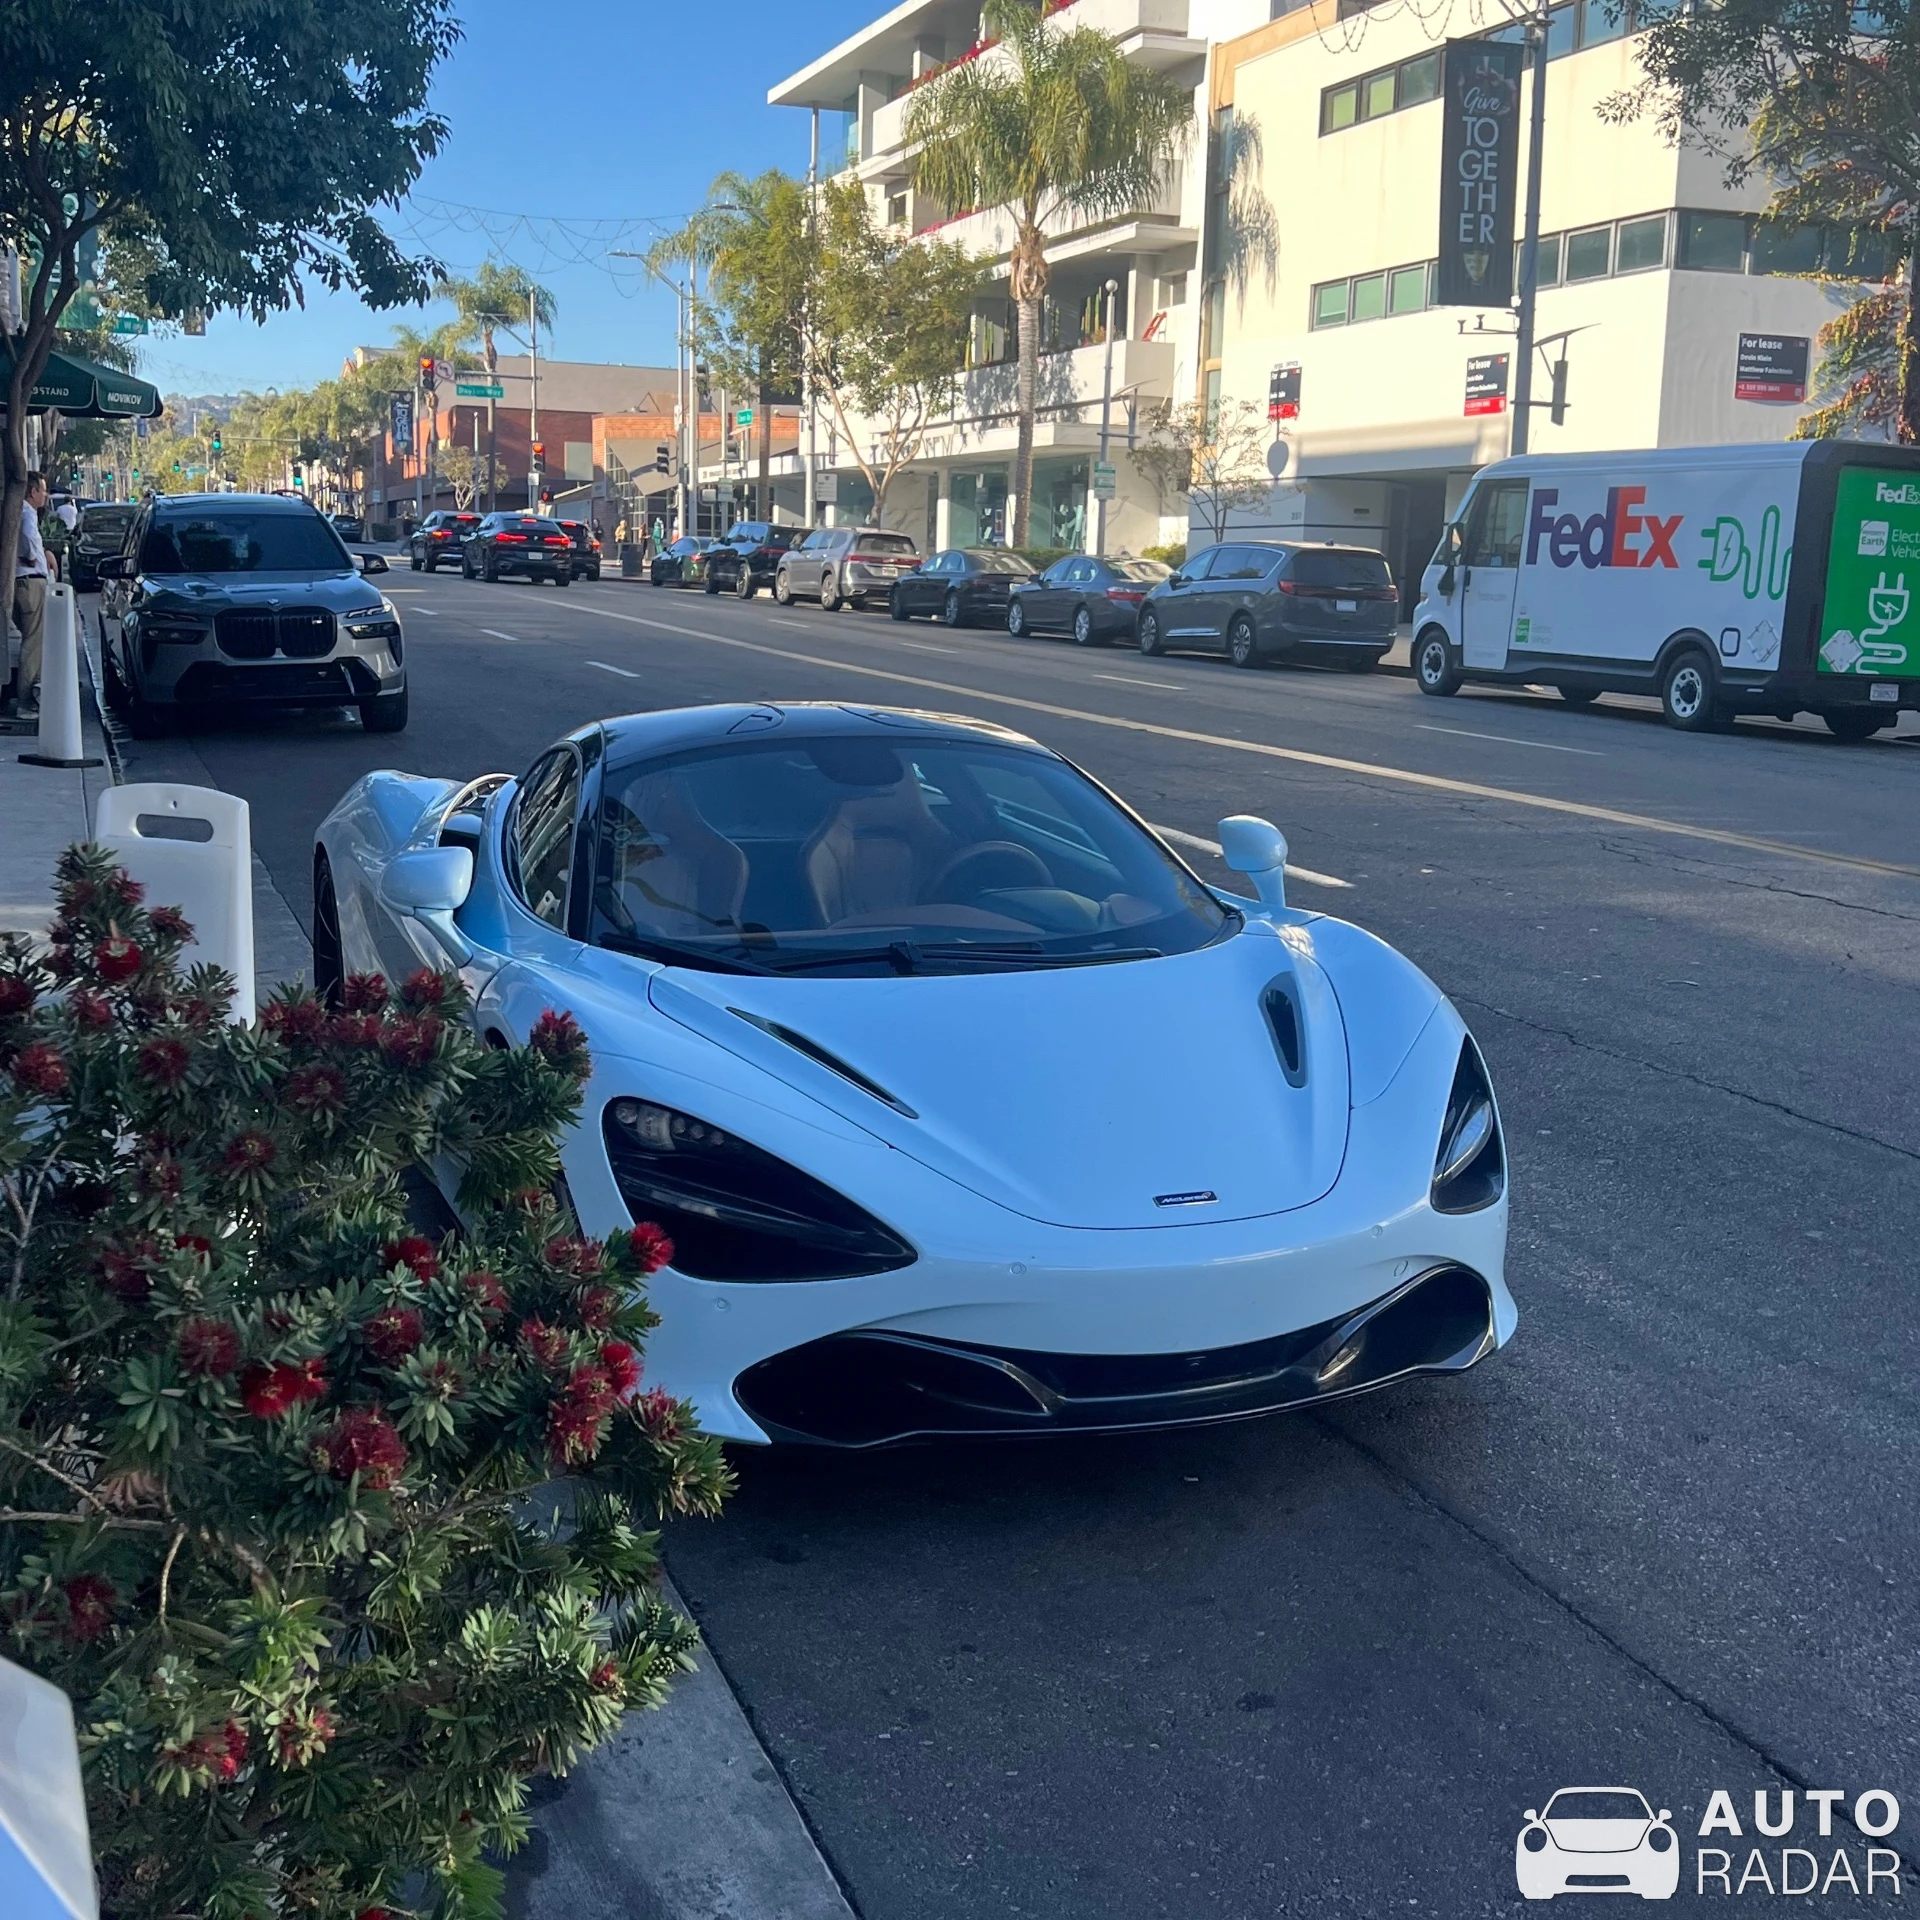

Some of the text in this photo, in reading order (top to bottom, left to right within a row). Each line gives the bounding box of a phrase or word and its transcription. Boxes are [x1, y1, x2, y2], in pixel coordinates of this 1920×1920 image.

[1463, 86, 1501, 114] Give
[1741, 338, 1783, 349] For lease
[107, 392, 143, 405] NOVIKOV
[1526, 486, 1684, 568] FedEx
[1861, 536, 1885, 546] Earth
[1161, 1195, 1208, 1203] McLaren
